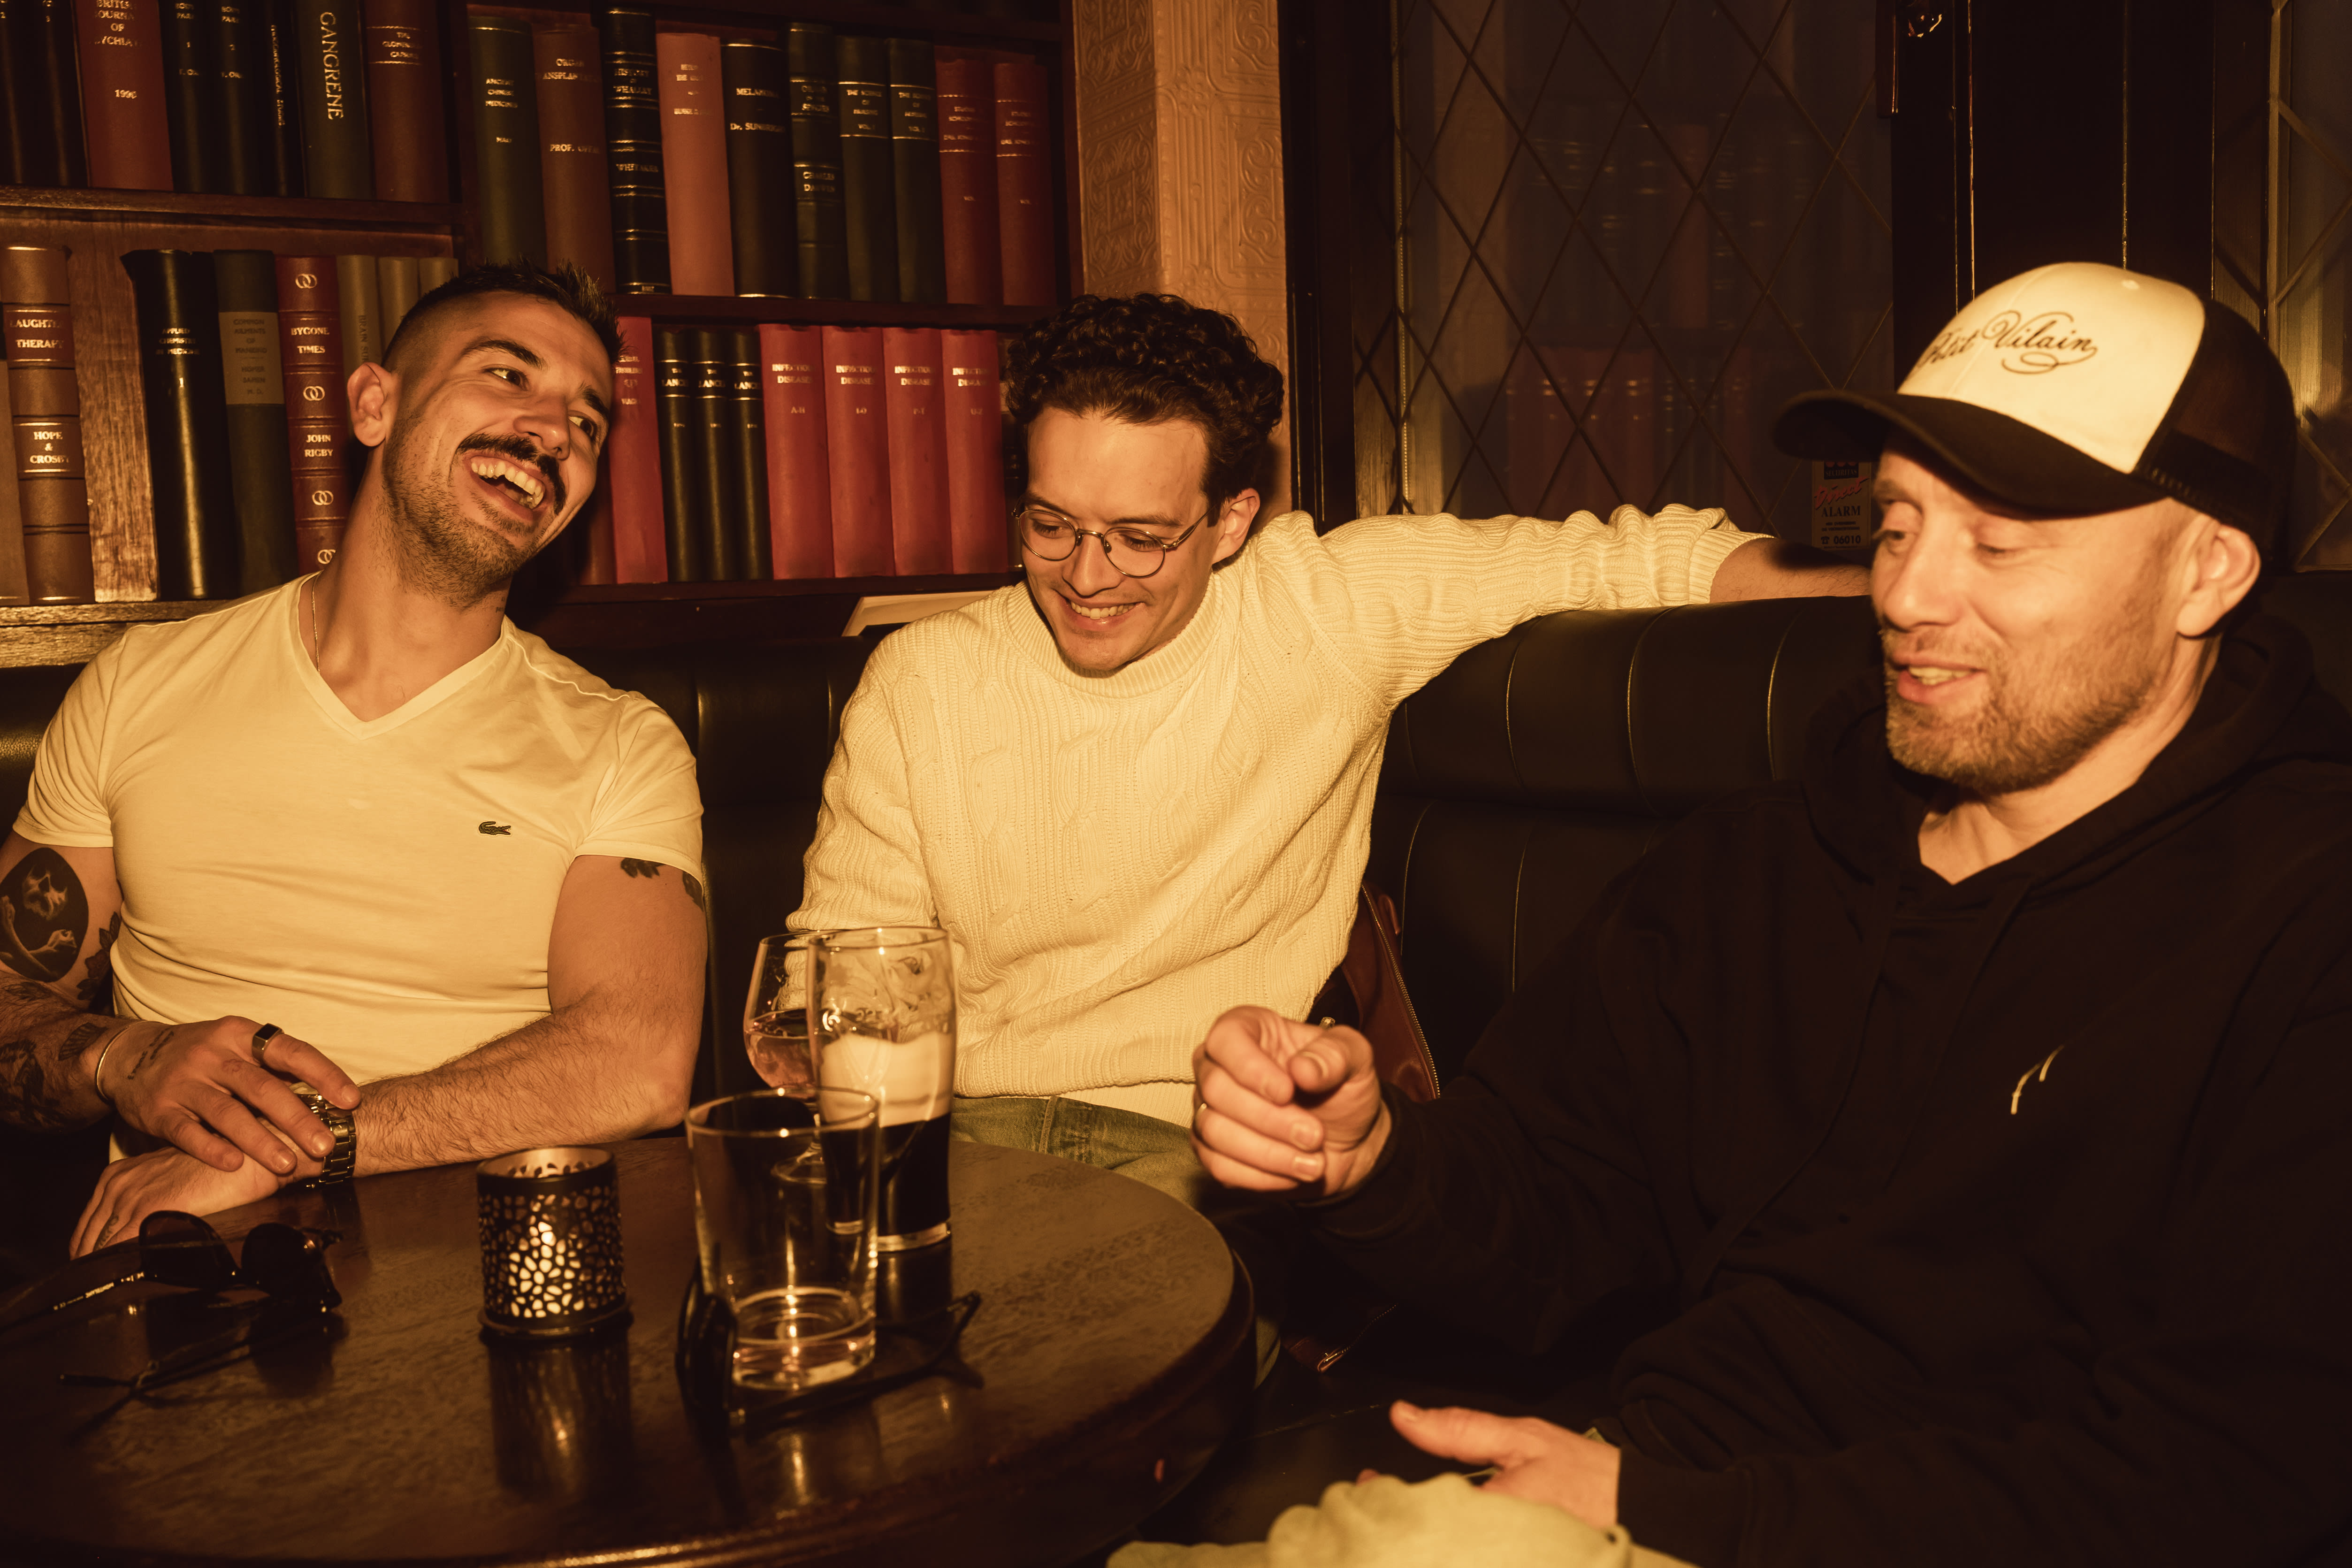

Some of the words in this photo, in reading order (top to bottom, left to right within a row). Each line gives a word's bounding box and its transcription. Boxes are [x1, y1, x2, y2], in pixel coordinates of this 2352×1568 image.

[96, 0, 137, 9] BRITIS
[94, 10, 136, 20] OURNA
[110, 23, 125, 32] OF
[320, 11, 344, 120] GANGRENE
[736, 88, 780, 98] MELANOM
[550, 144, 575, 152] PROF.
[10, 319, 63, 329] LAUGHTE
[359, 315, 370, 342] BRAIN
[291, 327, 330, 336] BYGONE
[15, 339, 64, 349] THERAPY
[1981, 310, 2098, 371] Vilain
[297, 345, 326, 354] TIMES
[661, 378, 689, 387] LANCE
[698, 379, 726, 388] LANCE
[733, 381, 761, 390] LANCE
[958, 378, 985, 387] DISEA
[33, 431, 63, 440] HOPE
[306, 435, 331, 443] JOHN
[45, 443, 53, 451] &
[304, 449, 334, 458] RIGBY
[30, 455, 70, 464] CROSBY
[1825, 469, 1858, 477] SECURITAS
[1814, 476, 1870, 510] Direct
[1822, 505, 1861, 517] ALARM
[1833, 535, 1861, 545] 06010
